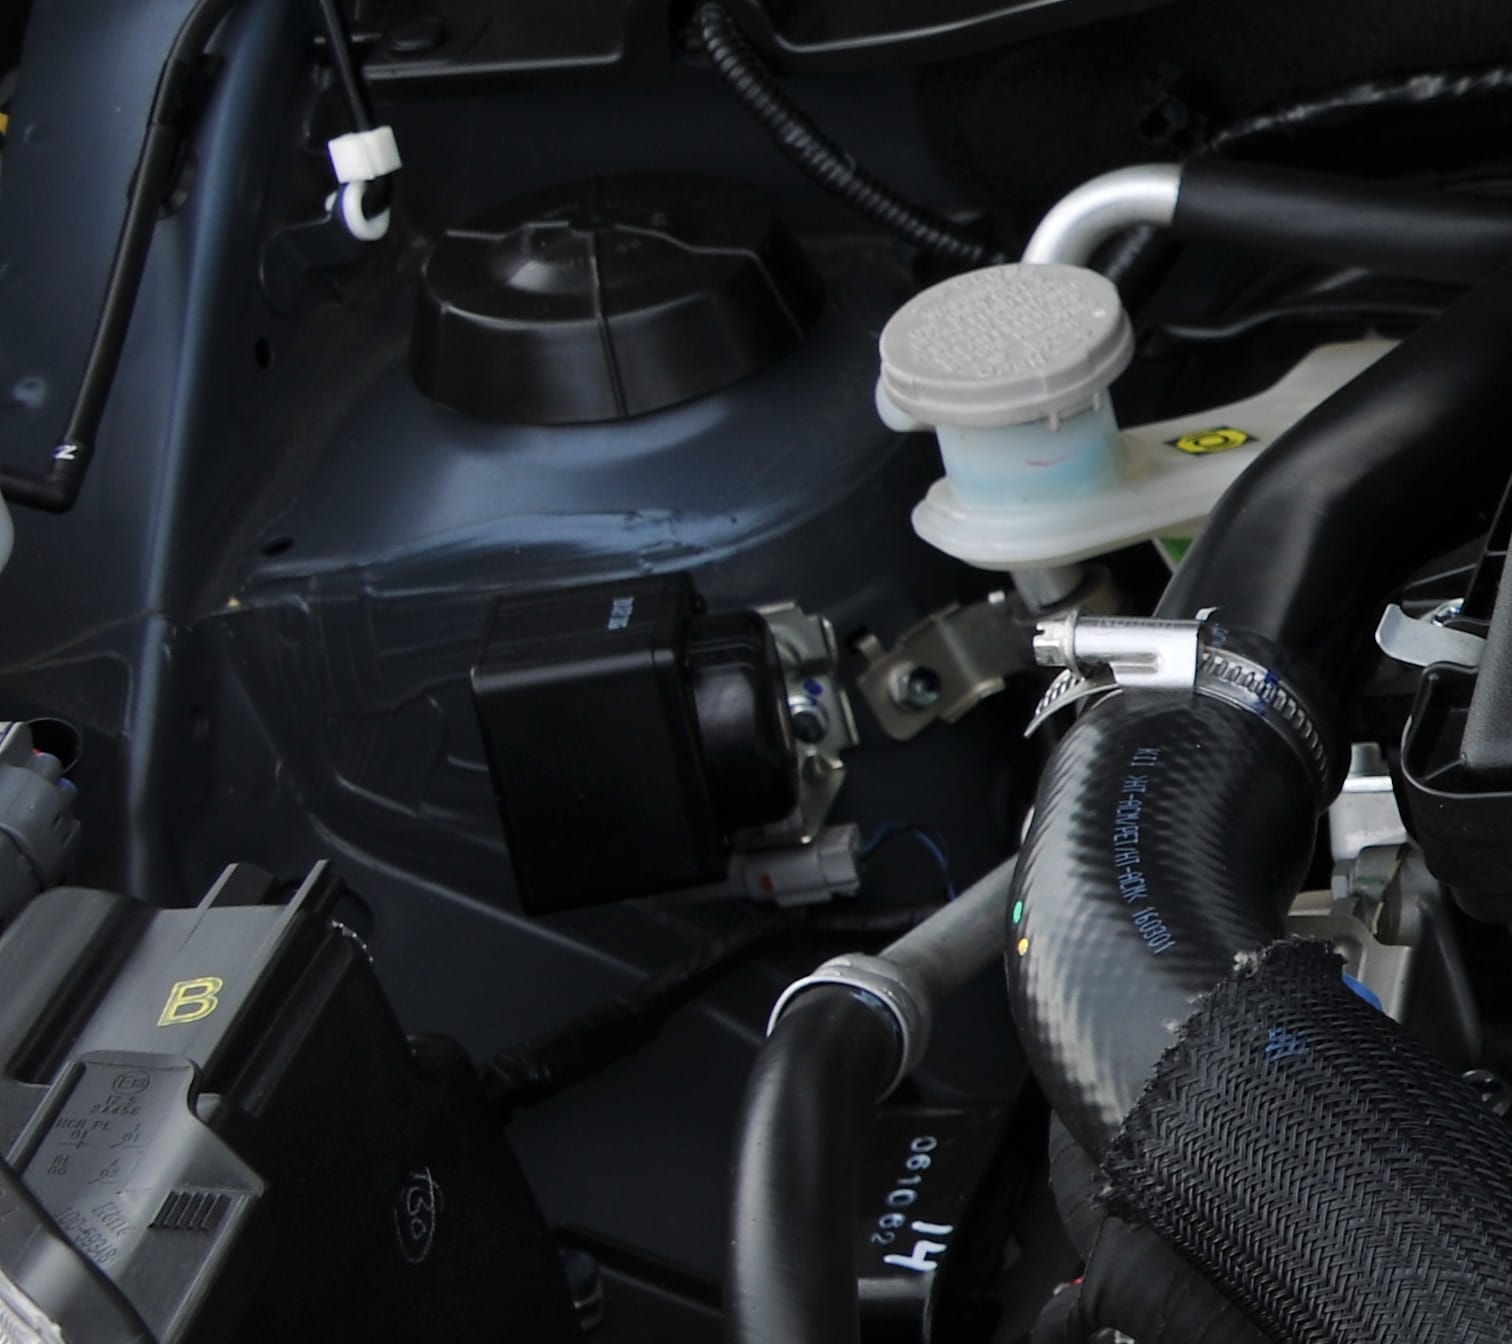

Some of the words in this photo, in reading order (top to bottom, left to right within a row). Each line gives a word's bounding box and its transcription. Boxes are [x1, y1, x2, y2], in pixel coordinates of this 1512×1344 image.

[1131, 905, 1176, 954] 160301
[157, 977, 223, 1028] B
[883, 1217, 955, 1274] 14
